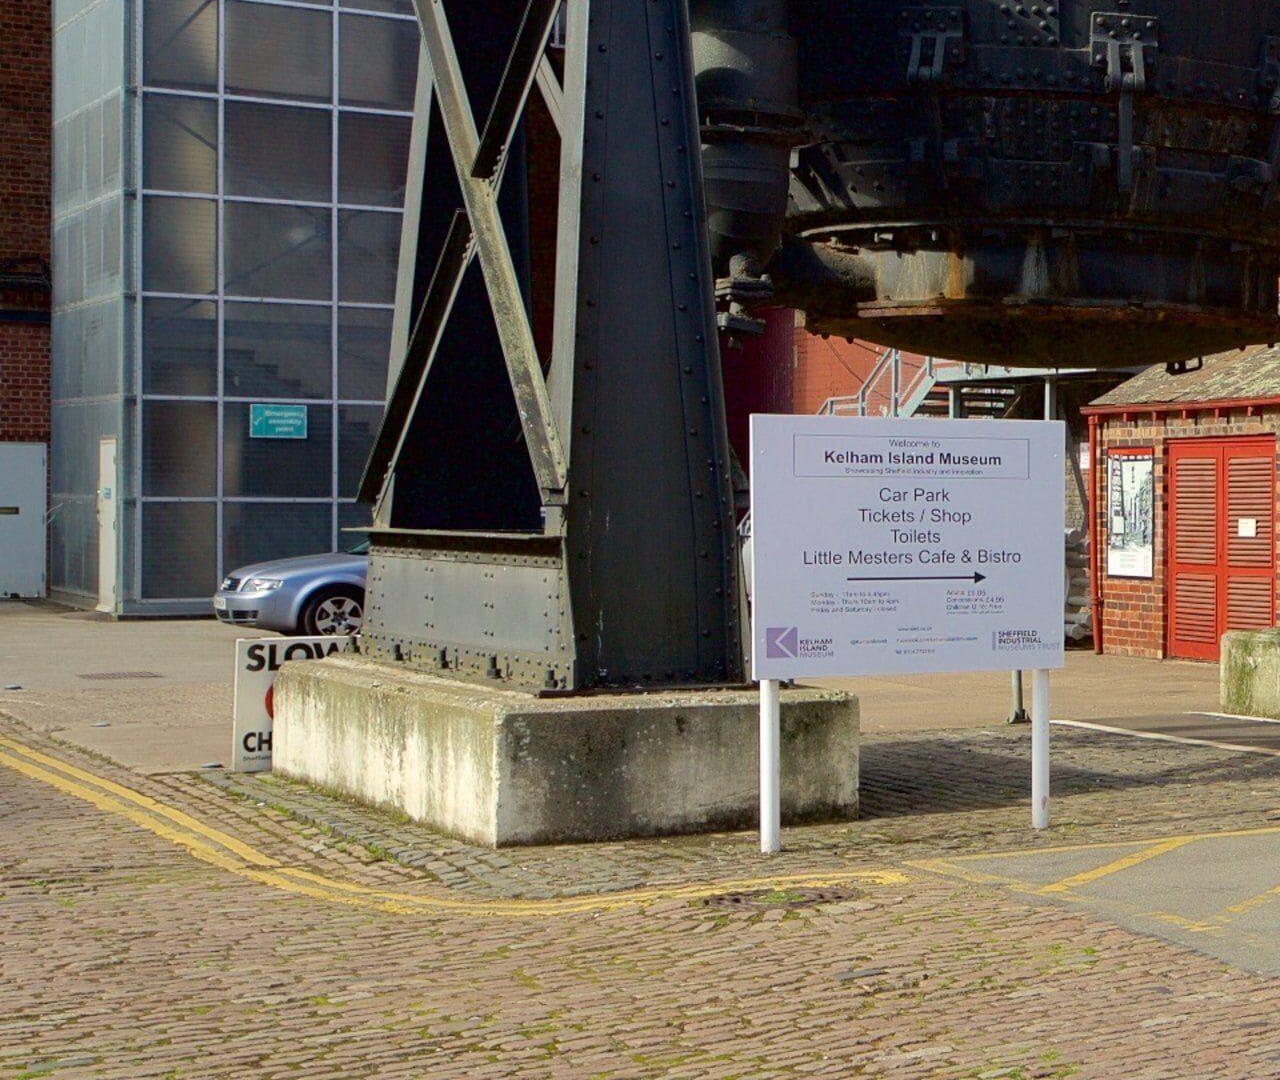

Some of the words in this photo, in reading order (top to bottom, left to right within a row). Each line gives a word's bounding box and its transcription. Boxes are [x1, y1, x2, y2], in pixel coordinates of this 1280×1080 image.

[889, 439, 929, 448] Welcome
[931, 439, 941, 448] to
[824, 450, 883, 465] Kelham
[888, 451, 934, 466] Island
[939, 452, 1002, 467] Museum
[879, 487, 909, 502] Car
[914, 488, 951, 502] Park
[858, 508, 915, 523] Tickets
[920, 508, 926, 523] /
[930, 508, 972, 526] Shop
[890, 529, 941, 544] Toilets
[803, 550, 842, 565] Little
[849, 550, 913, 565] Mesters
[918, 549, 956, 564] Cafe
[961, 549, 973, 564] &
[978, 549, 1022, 564] Bistro
[998, 636, 1042, 644] INDUSTRIAL
[1038, 642, 1060, 650] TRUST
[799, 651, 835, 659] MUSEUM
